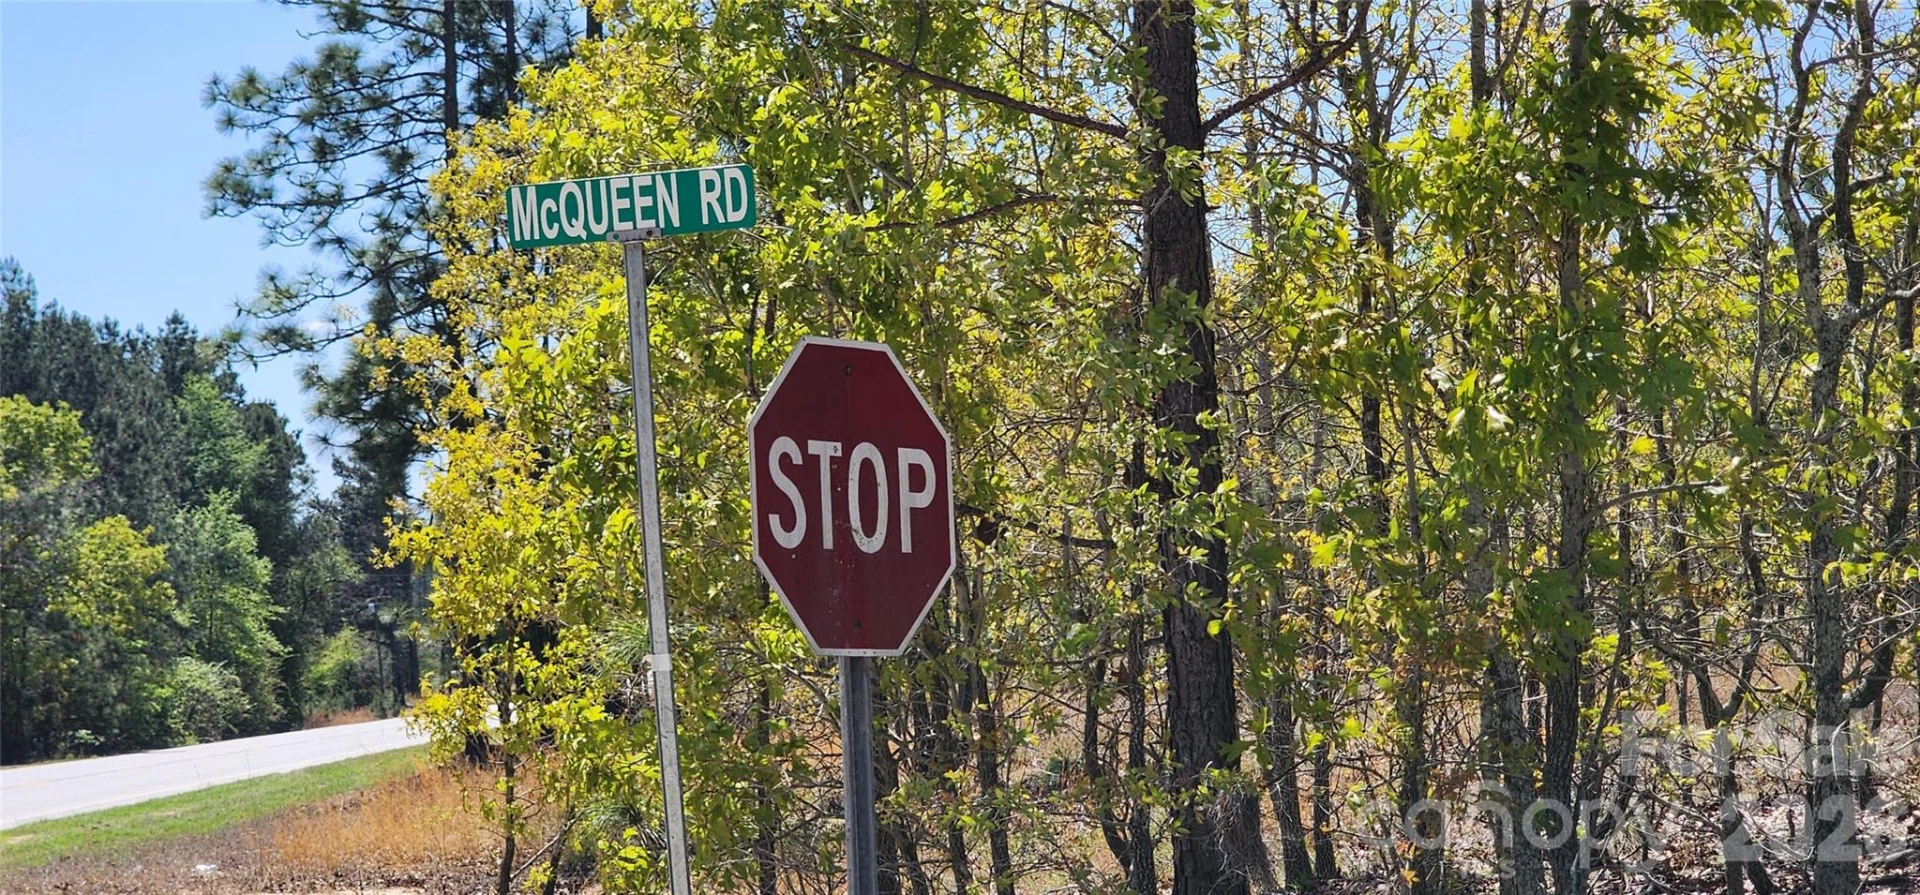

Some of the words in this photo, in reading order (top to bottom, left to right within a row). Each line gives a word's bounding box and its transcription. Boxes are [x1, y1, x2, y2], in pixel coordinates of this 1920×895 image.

[511, 173, 680, 241] McQUEEN
[699, 167, 748, 225] RD
[768, 435, 937, 554] STOP
